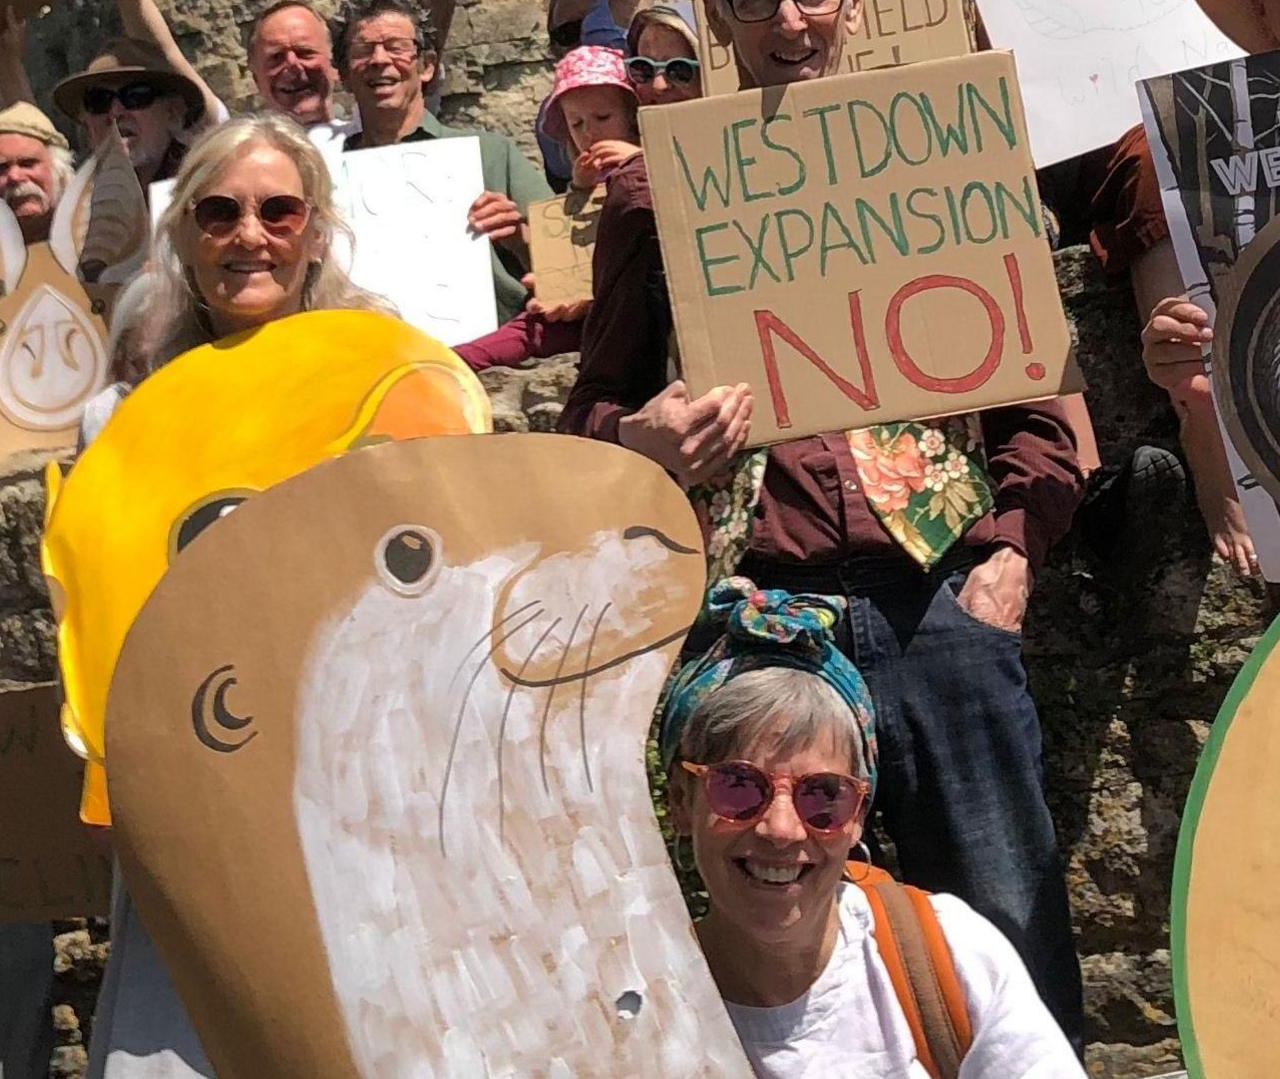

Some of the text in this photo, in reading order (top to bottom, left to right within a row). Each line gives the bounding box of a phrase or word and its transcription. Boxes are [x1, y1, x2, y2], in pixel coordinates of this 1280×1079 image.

[673, 77, 1018, 212] WESTDOWN
[695, 176, 1043, 298] EXPANSION
[754, 253, 1047, 430] NO!
